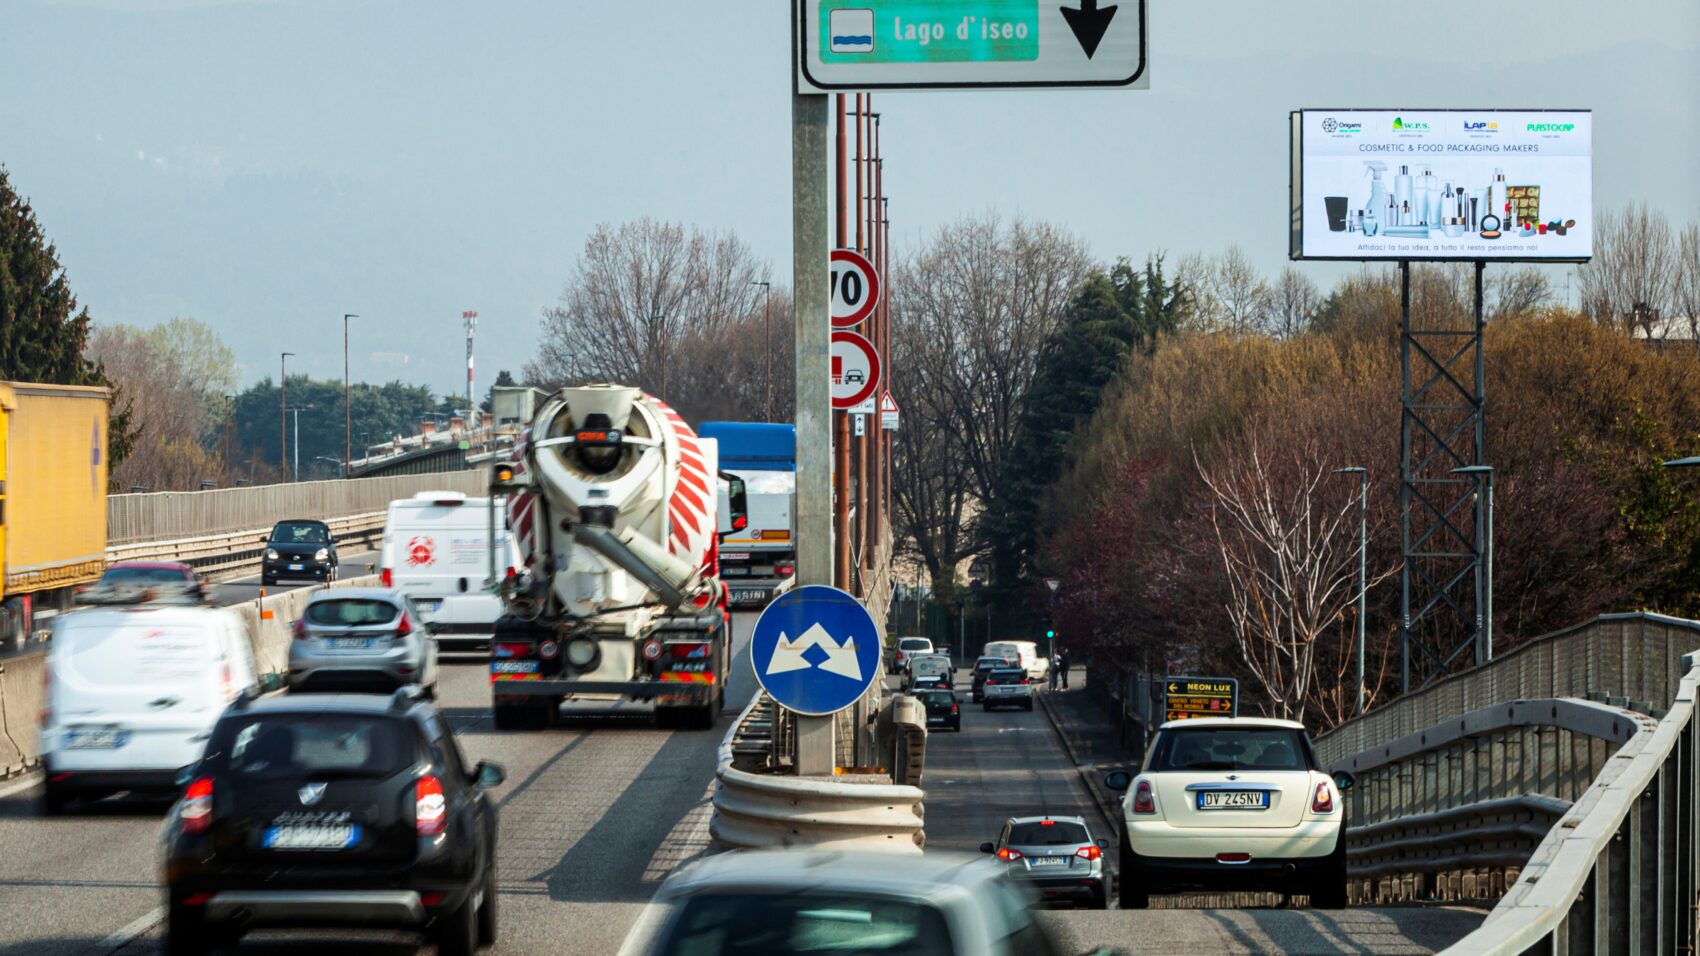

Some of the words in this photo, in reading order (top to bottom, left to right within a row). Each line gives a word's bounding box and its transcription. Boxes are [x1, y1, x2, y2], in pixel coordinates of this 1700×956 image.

[1338, 121, 1362, 130] Origami
[1526, 122, 1575, 132] PLASTOCAP
[1358, 143, 1405, 153] COSMETIC
[1407, 144, 1414, 152] &
[1417, 143, 1444, 153] FOOD
[1446, 143, 1500, 153] PACKAGING
[1502, 143, 1540, 153] MAKERS
[1388, 243, 1396, 252] la
[1412, 243, 1431, 253] idea,
[1441, 243, 1458, 252] tutto
[1467, 244, 1486, 252] resto
[1487, 244, 1525, 253] pensiamo
[1527, 244, 1539, 252] noi
[1187, 683, 1212, 691] NEON
[1189, 697, 1209, 705] VENETO
[1205, 793, 1220, 805] DV
[1224, 793, 1261, 805] 245NV
